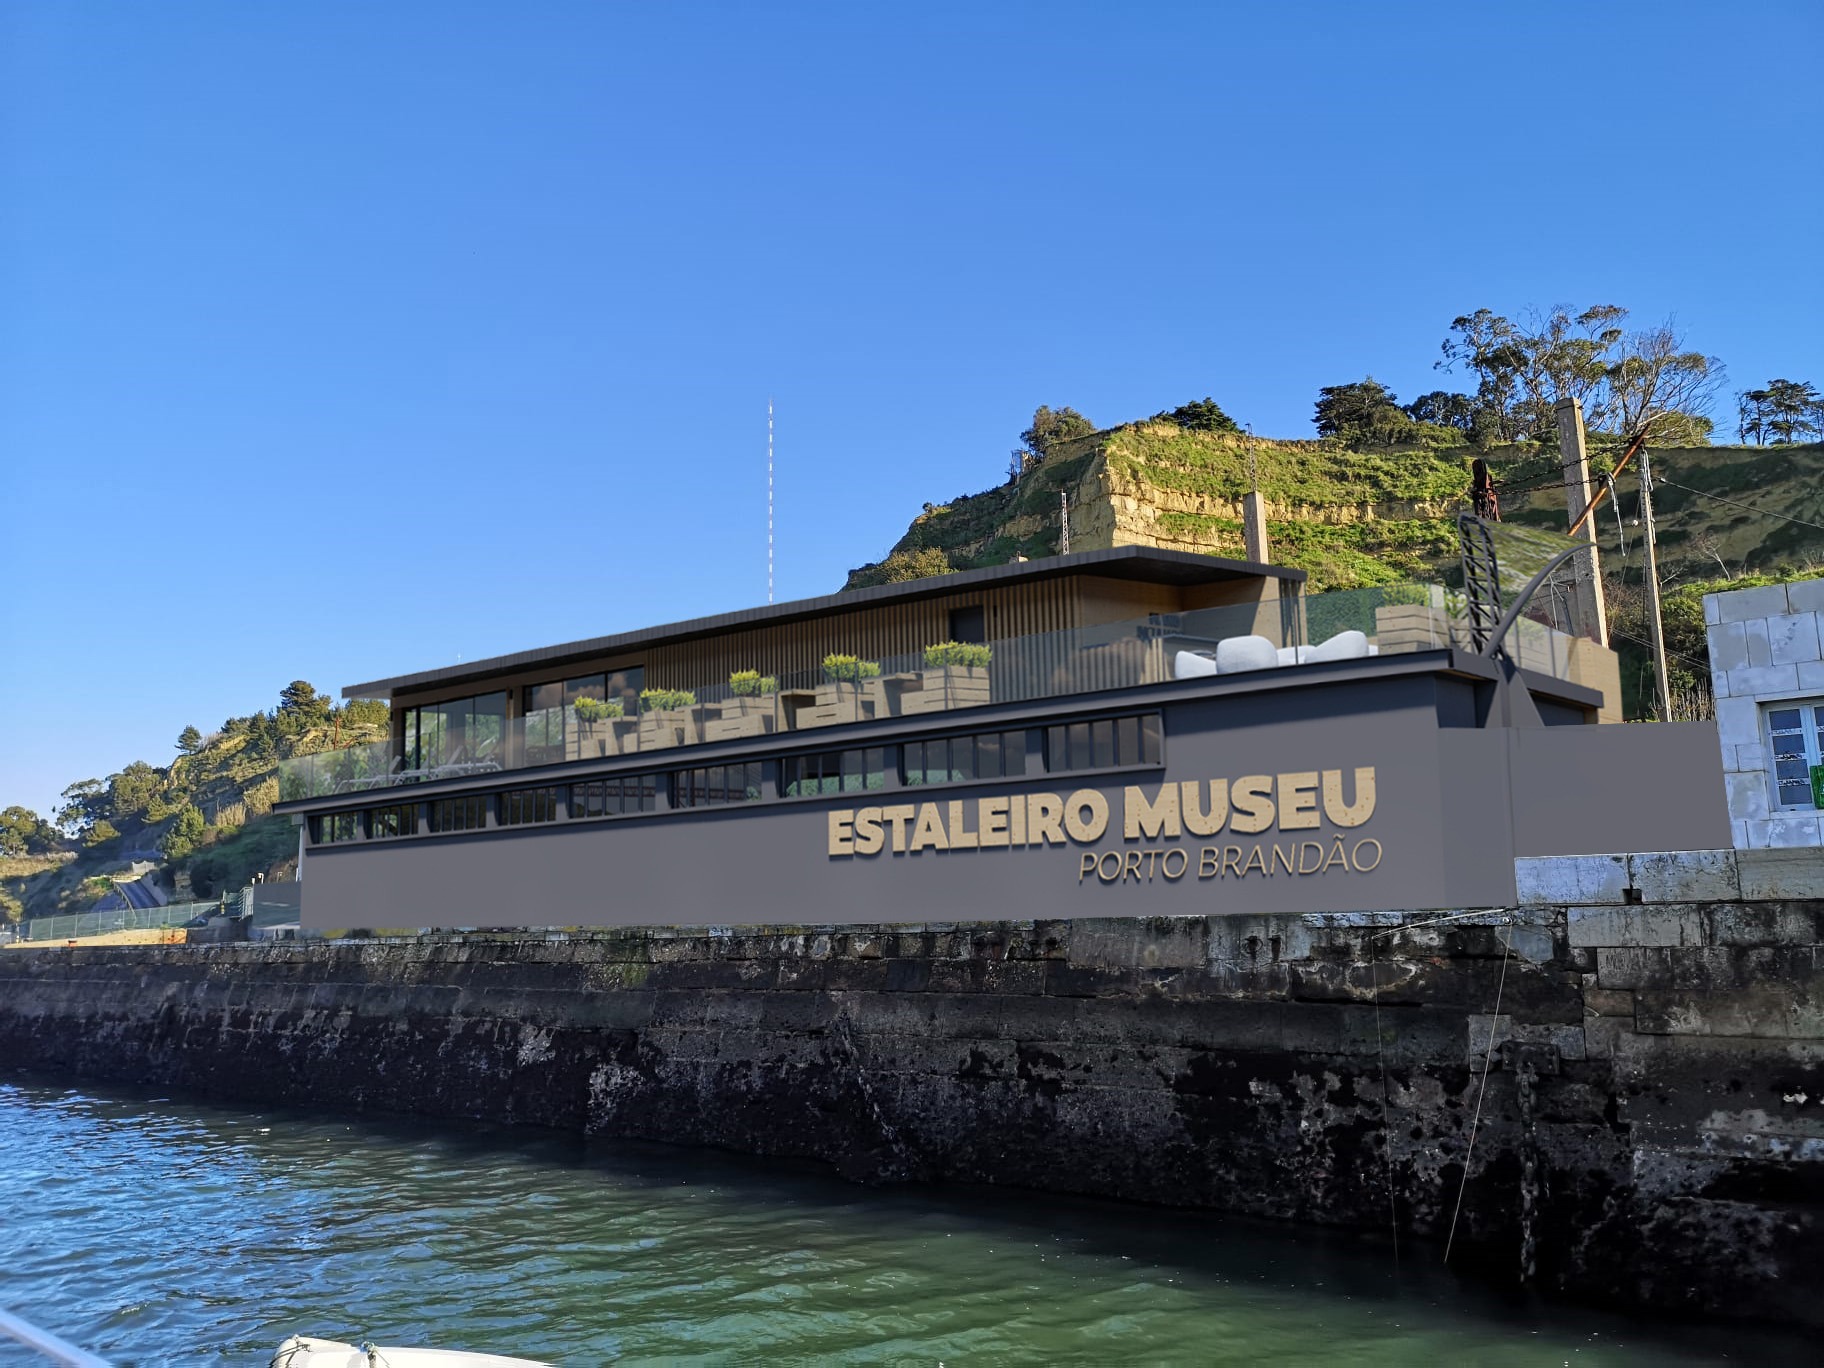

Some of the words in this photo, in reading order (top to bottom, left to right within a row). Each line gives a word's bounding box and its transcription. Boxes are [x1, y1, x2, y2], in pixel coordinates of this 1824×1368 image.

[828, 788, 1109, 856] ESTALEIRO
[1124, 766, 1377, 839] MUSEU
[1079, 848, 1188, 881] PORTO
[1198, 833, 1383, 879] BRANDÃO
